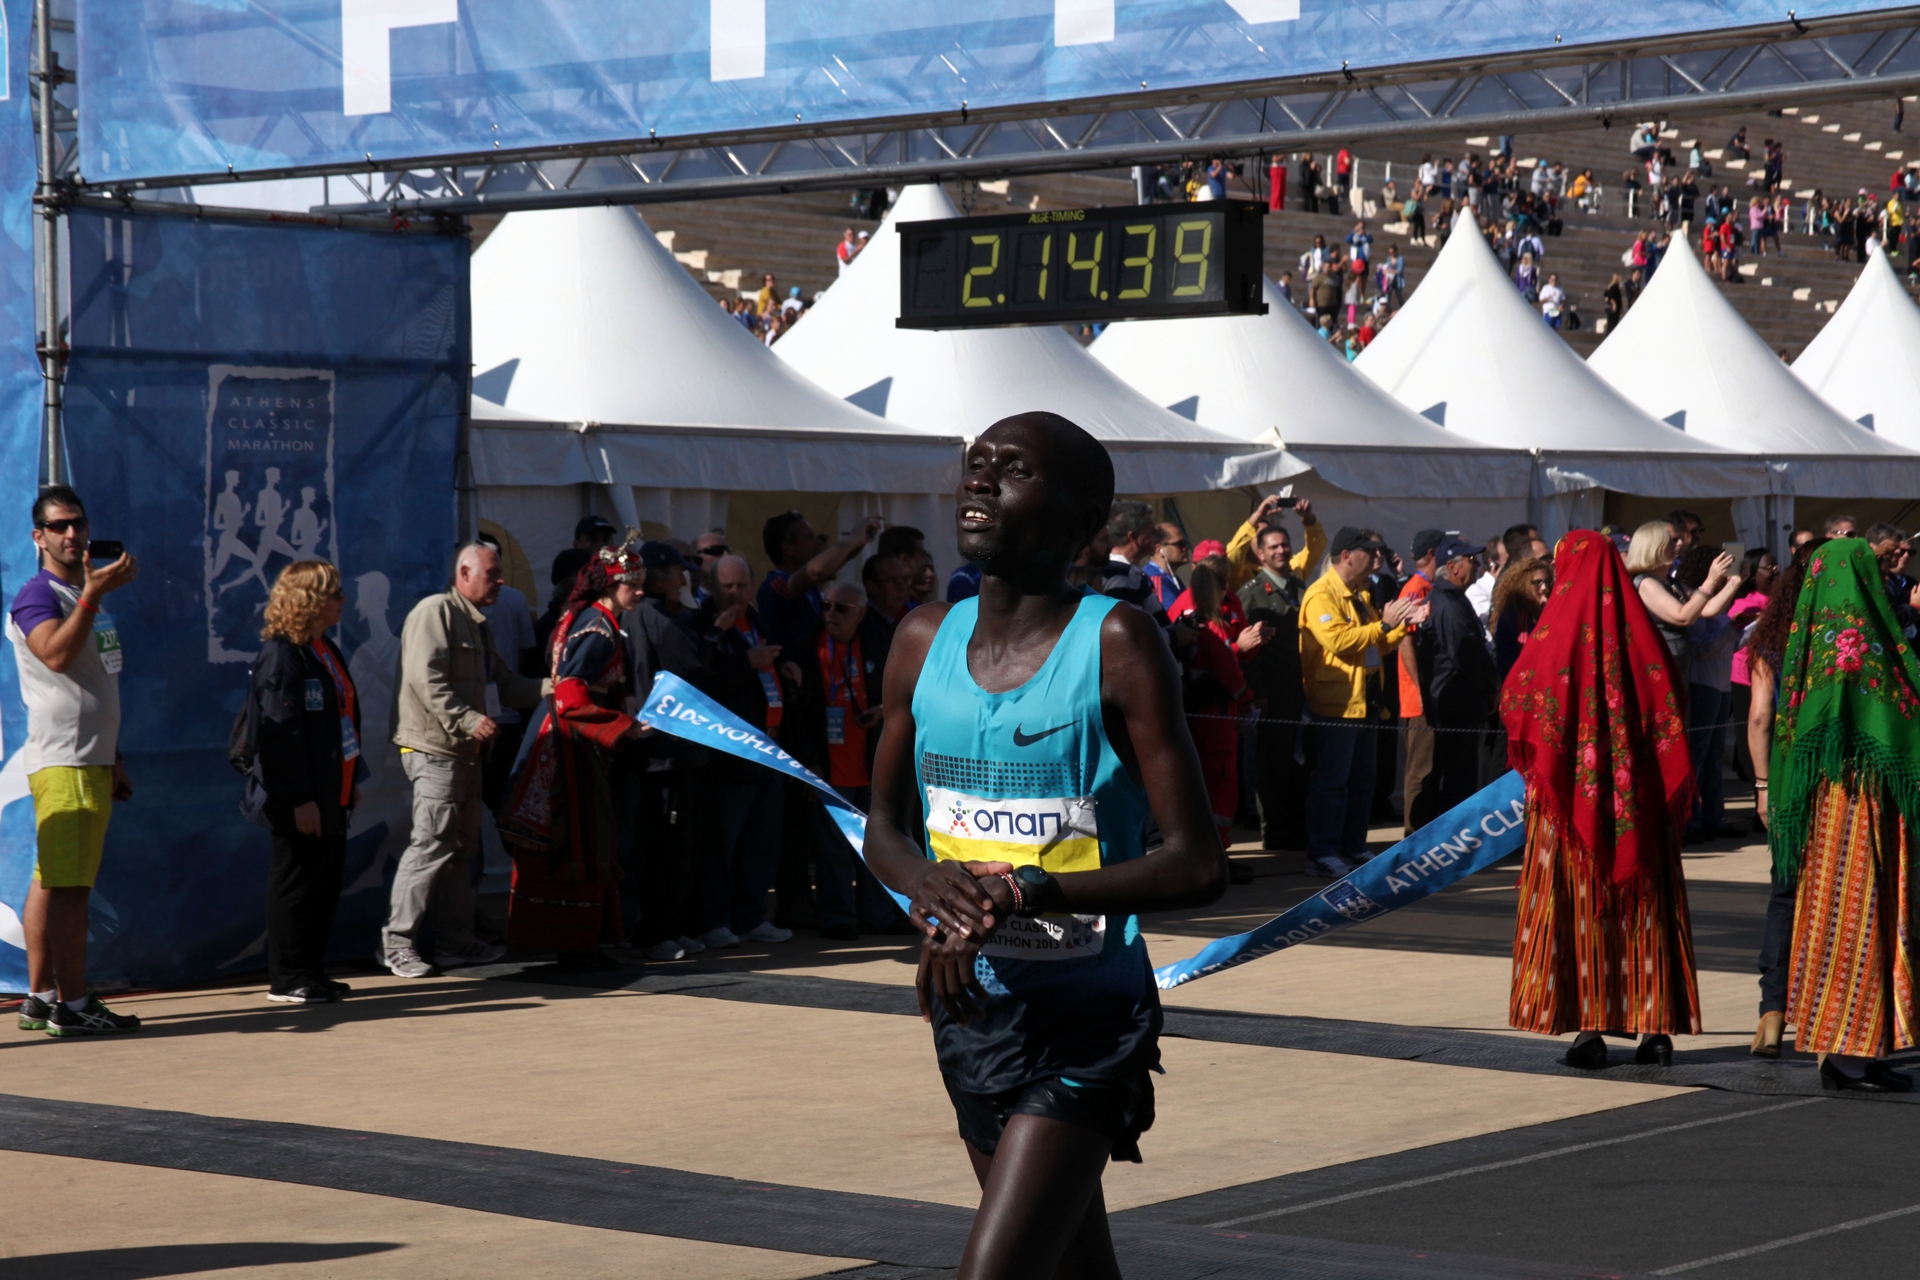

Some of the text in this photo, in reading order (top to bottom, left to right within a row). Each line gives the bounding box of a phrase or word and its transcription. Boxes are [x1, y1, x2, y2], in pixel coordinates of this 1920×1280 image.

[230, 397, 315, 409] ATHENS
[228, 418, 315, 430] CLASSIC
[227, 439, 315, 451] MARATHON
[656, 694, 710, 727] 2013
[1385, 797, 1526, 894] ATHENS CLA
[1010, 919, 1063, 934] CLASSIC
[1274, 917, 1331, 947] 2013
[1035, 937, 1061, 950] 2013
